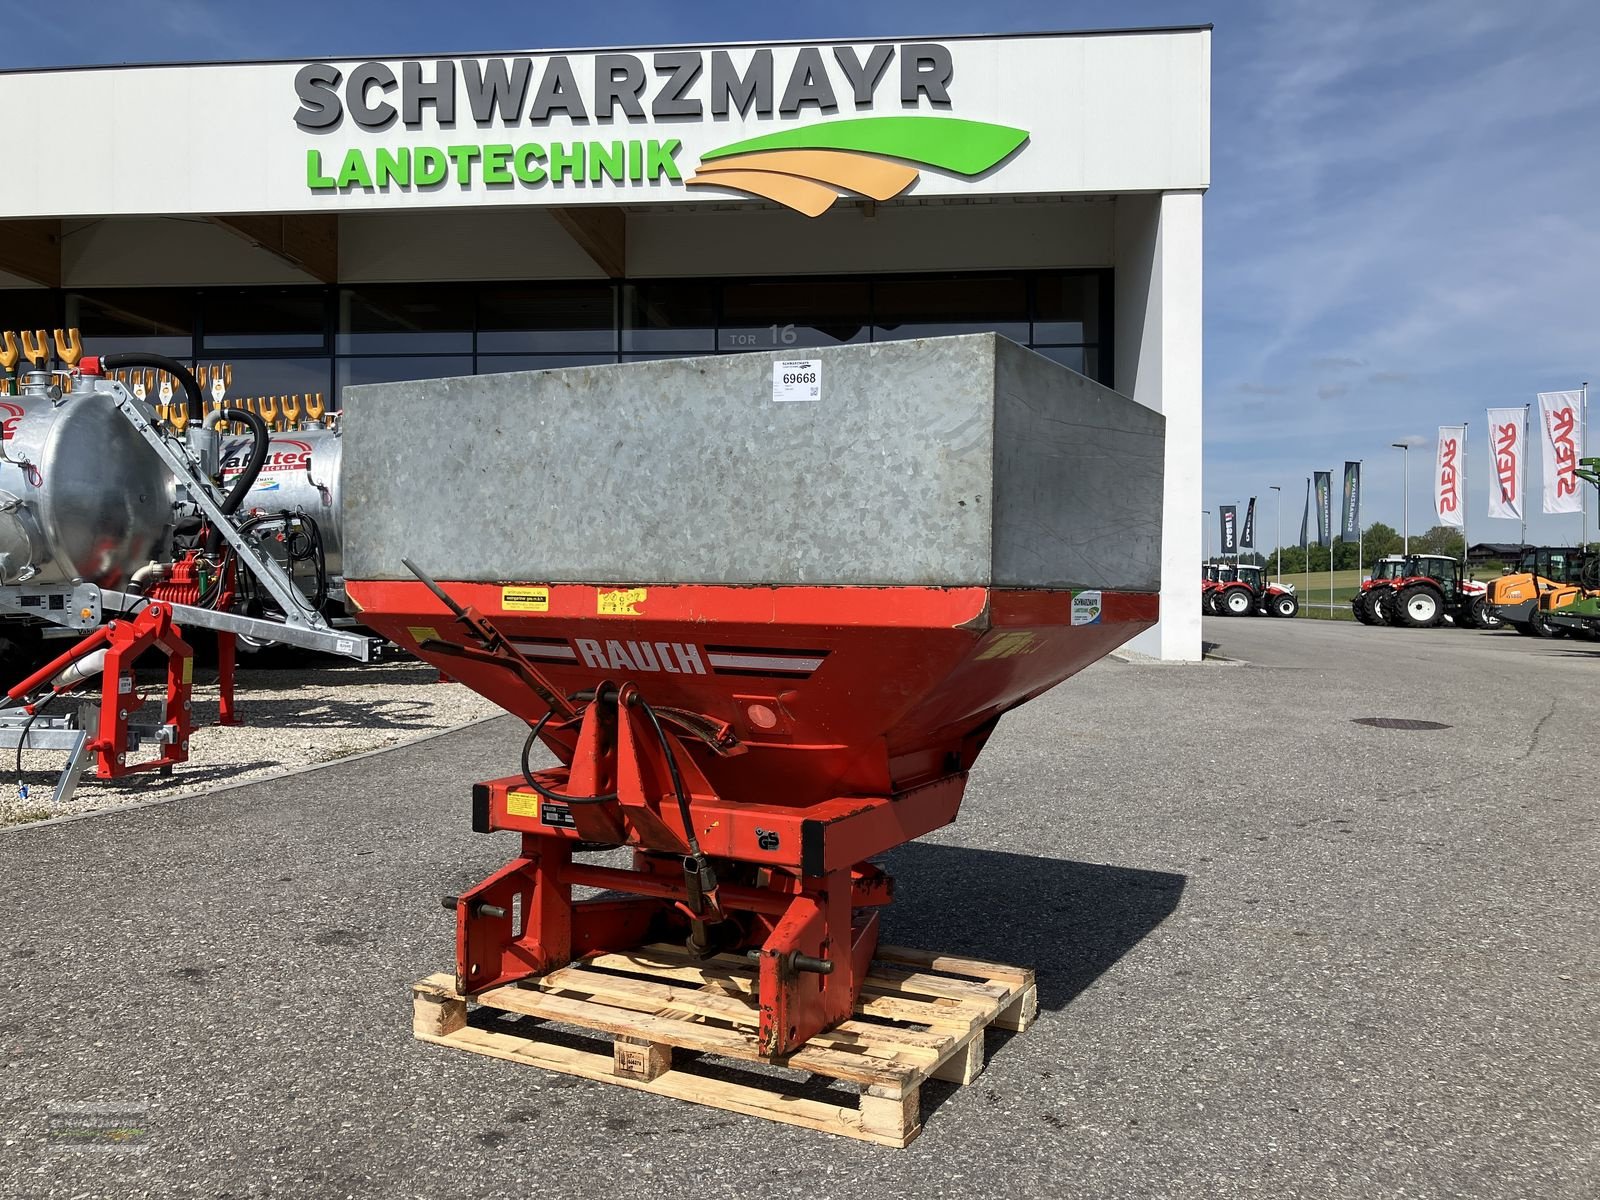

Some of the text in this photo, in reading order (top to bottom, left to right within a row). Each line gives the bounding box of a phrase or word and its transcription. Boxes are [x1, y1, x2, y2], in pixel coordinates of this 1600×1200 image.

[293, 43, 953, 129] SCHWARZMAYR
[306, 139, 682, 188] LANDTECHNIK
[730, 324, 797, 345] TOR 16
[783, 372, 816, 384] 69668
[574, 638, 707, 675] RAUCH
